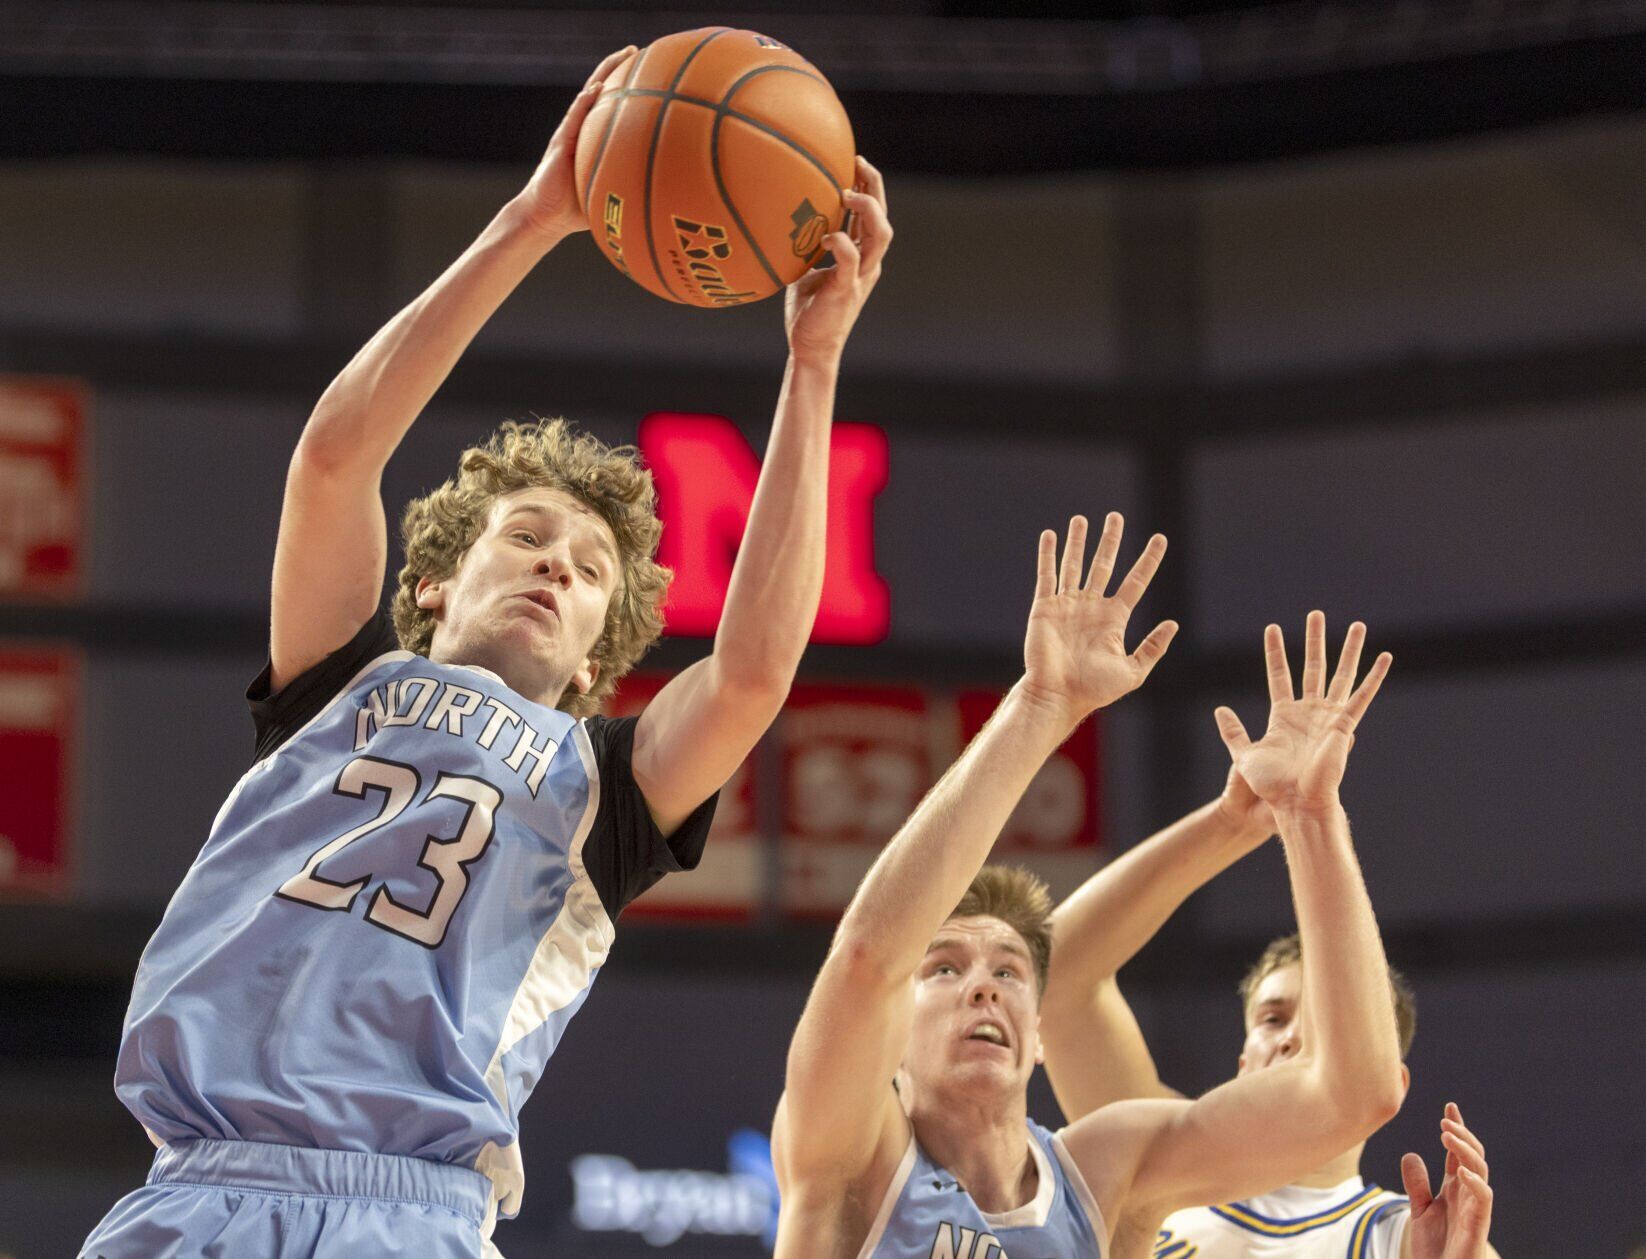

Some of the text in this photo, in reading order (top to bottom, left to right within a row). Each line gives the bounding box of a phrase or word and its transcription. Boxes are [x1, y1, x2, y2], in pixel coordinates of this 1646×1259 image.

[638, 411, 891, 648] N
[352, 676, 559, 800] NORTH
[273, 754, 504, 950] 23
